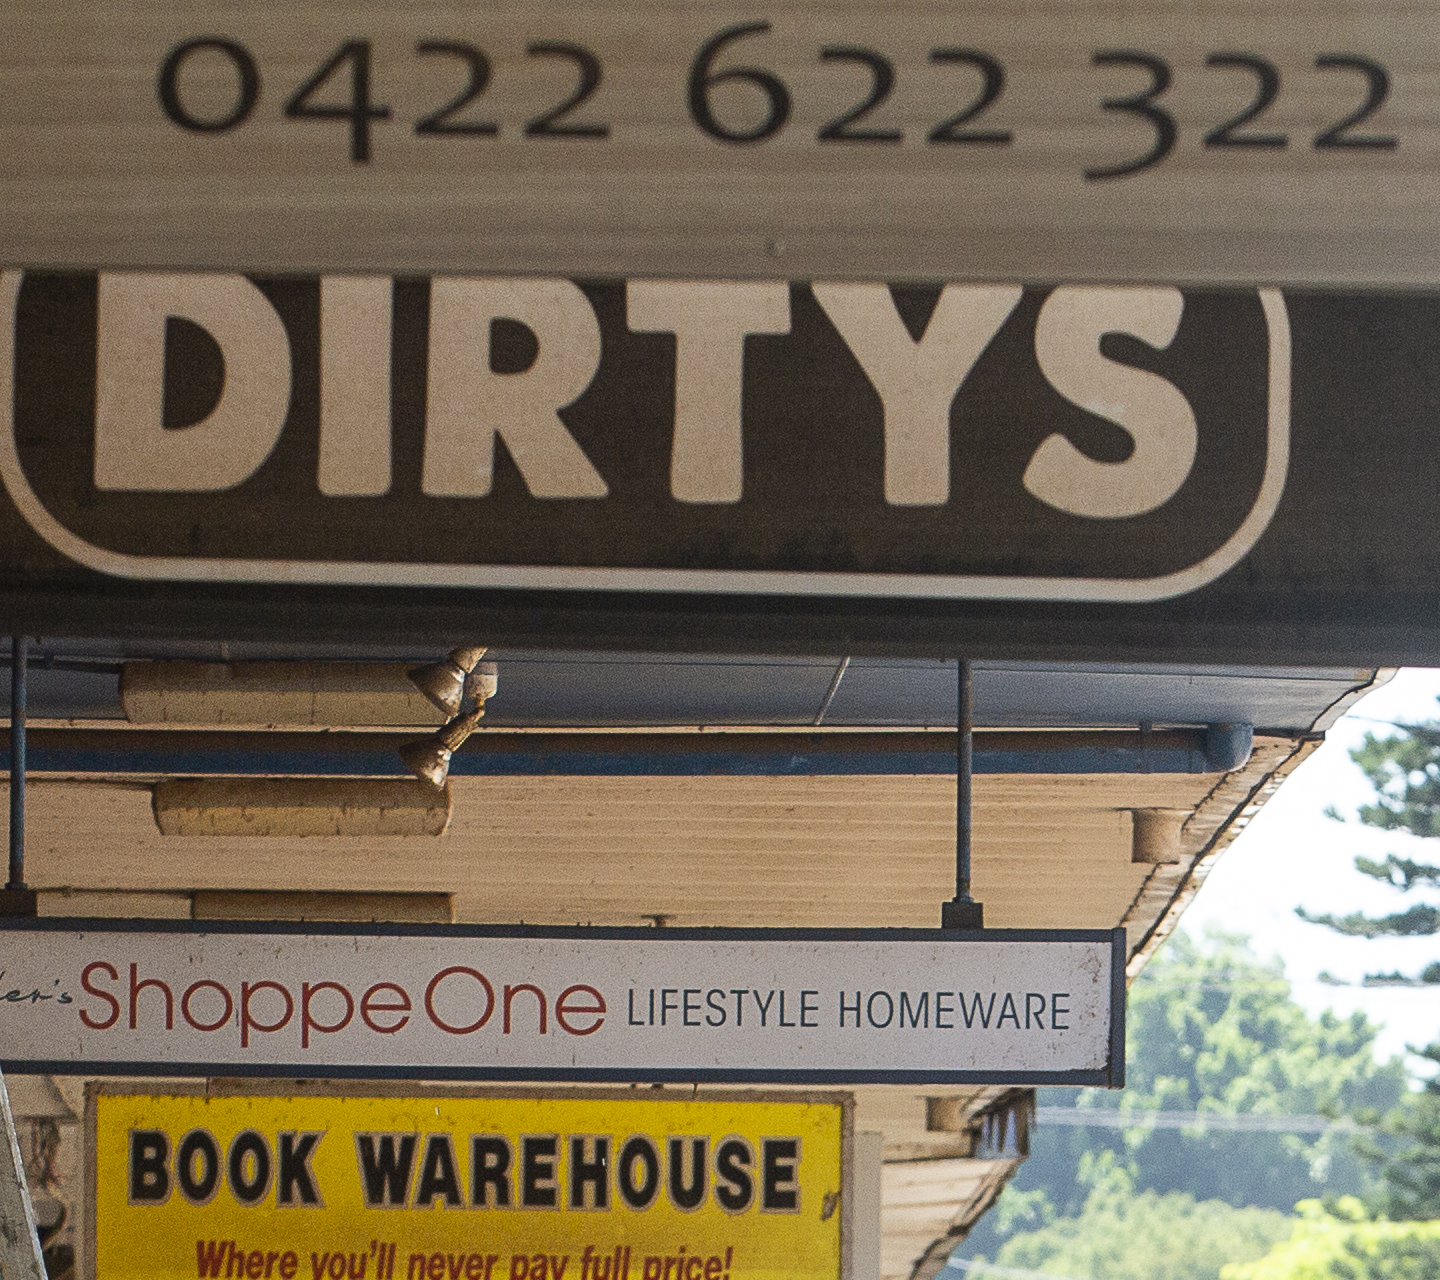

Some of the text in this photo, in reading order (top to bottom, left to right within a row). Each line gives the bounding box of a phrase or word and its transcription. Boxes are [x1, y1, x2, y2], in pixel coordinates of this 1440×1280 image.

[155, 19, 1400, 182] 0422 622 322
[93, 270, 1200, 519] DIRTYS
[627, 987, 819, 1029] LIFESTYLE
[839, 991, 1071, 1032] HOMEWARE
[128, 1126, 803, 1215] BOOK WAREHOUSE
[195, 1239, 298, 1280] Where
